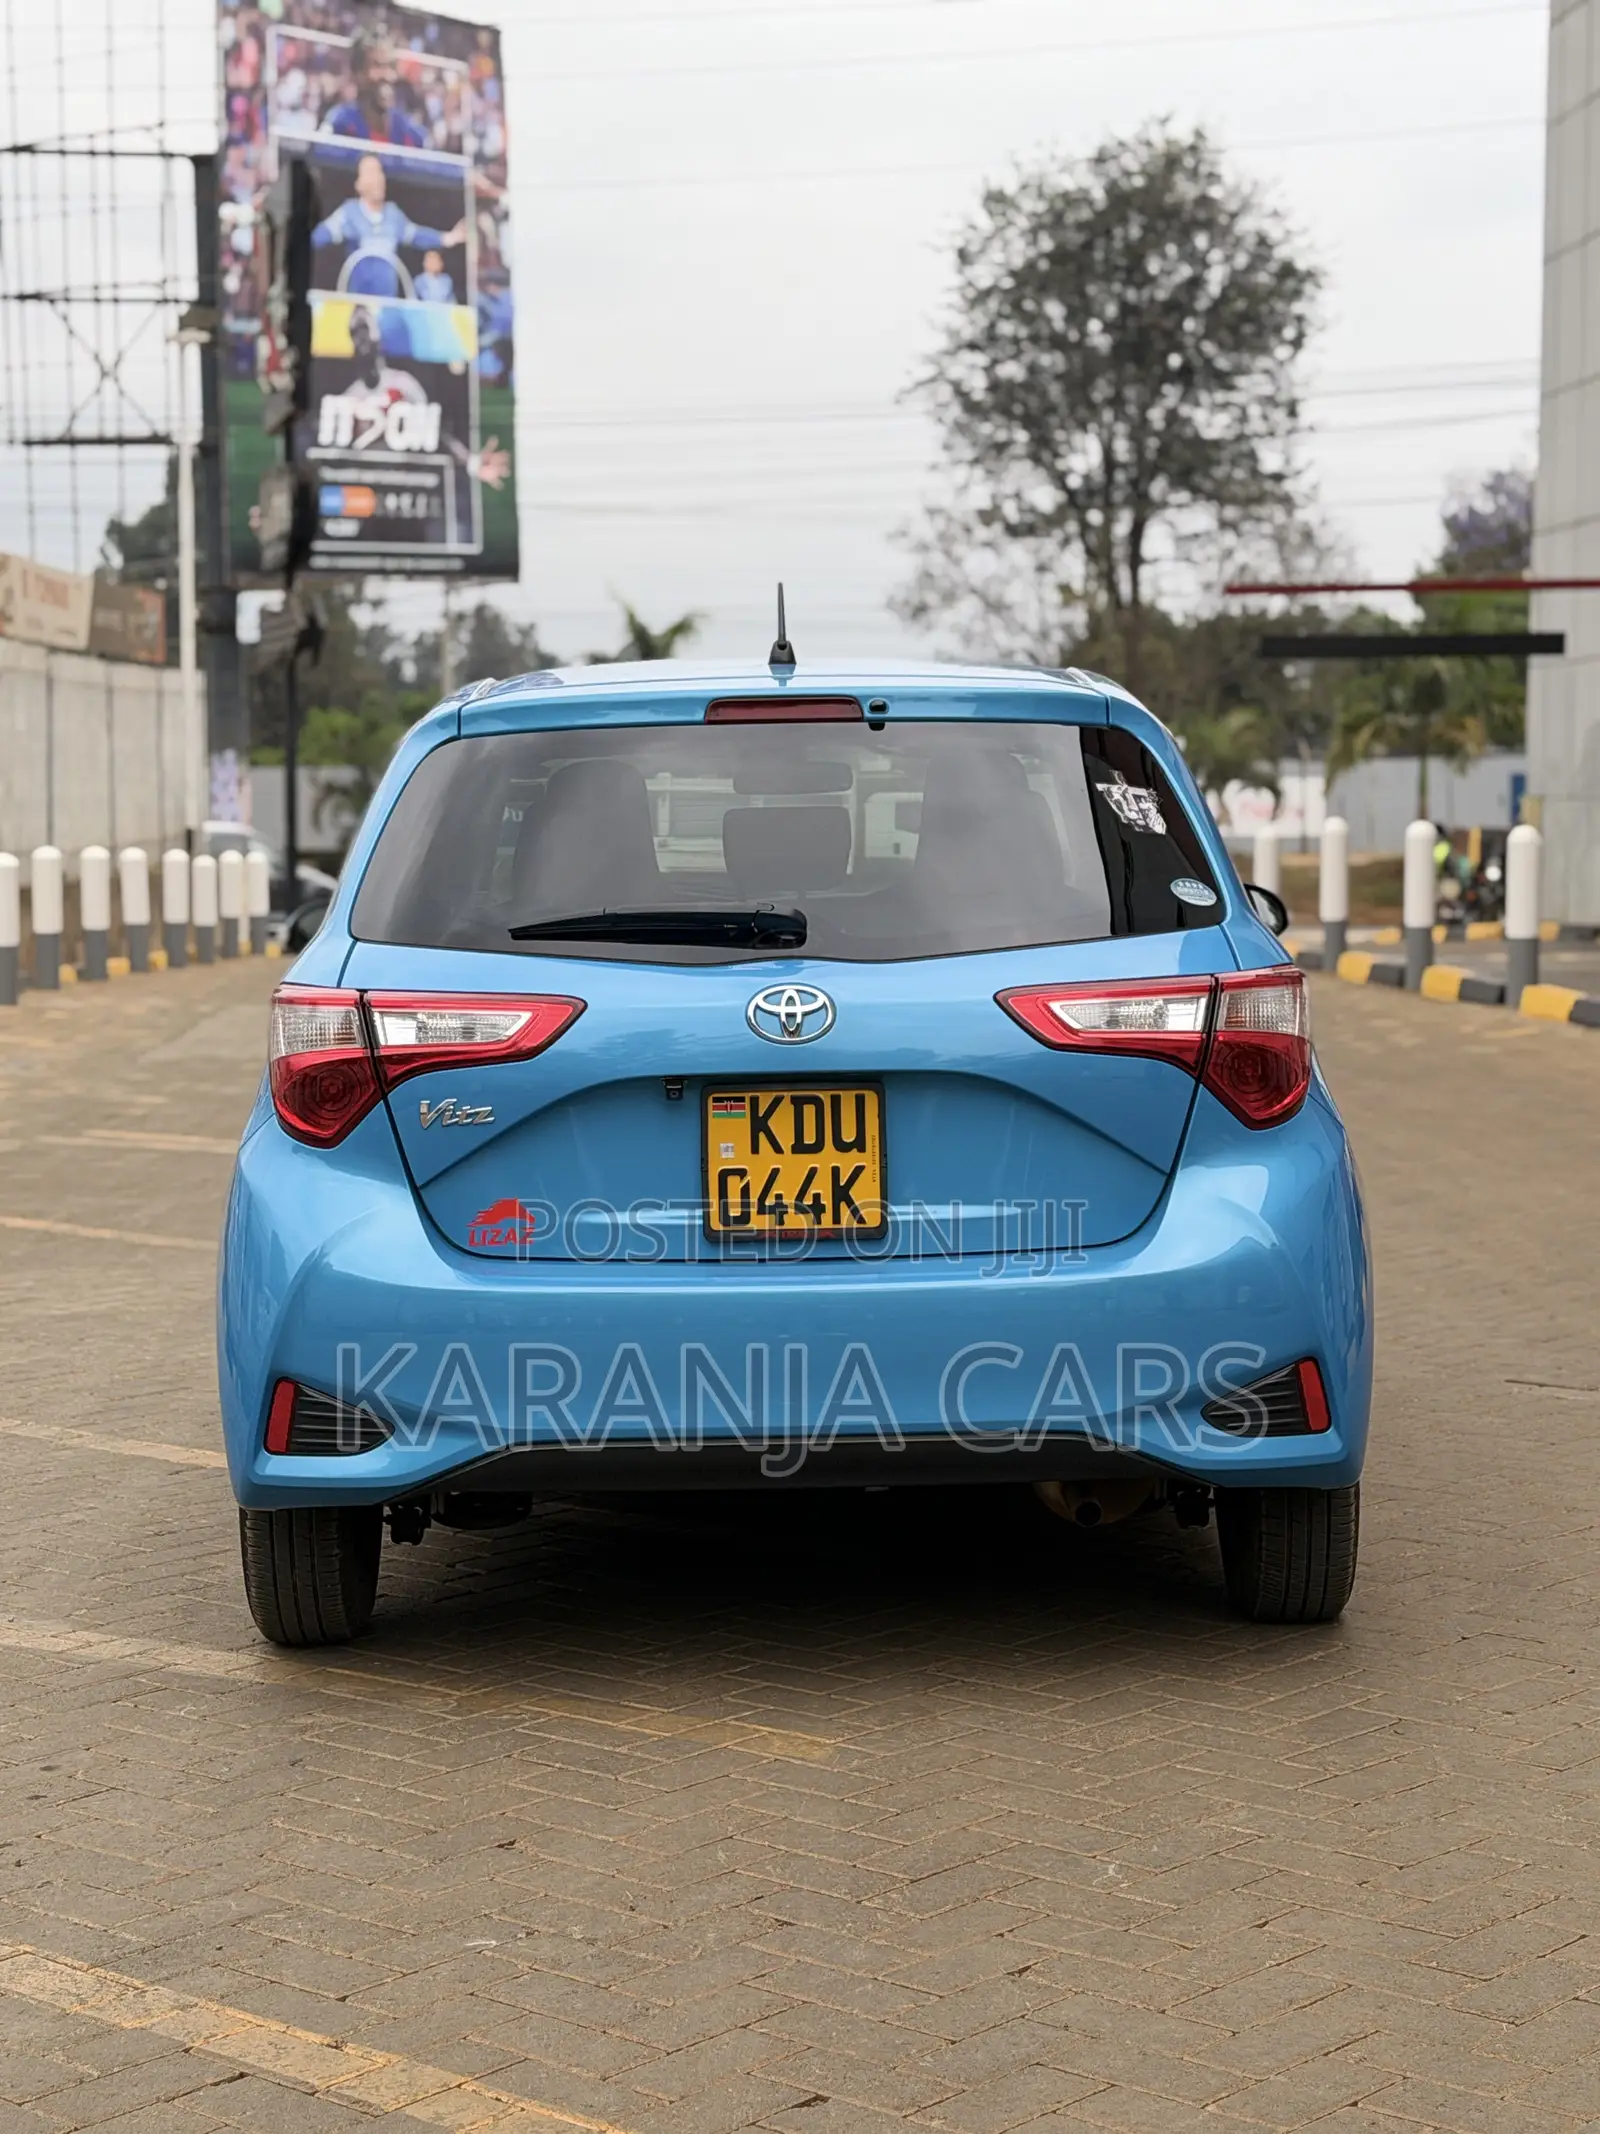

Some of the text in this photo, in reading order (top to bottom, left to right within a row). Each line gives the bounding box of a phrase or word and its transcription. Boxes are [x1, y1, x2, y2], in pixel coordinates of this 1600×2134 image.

[419, 1098, 495, 1130] Vitz
[750, 1093, 866, 1155] KDU
[717, 1164, 867, 1227] 044K
